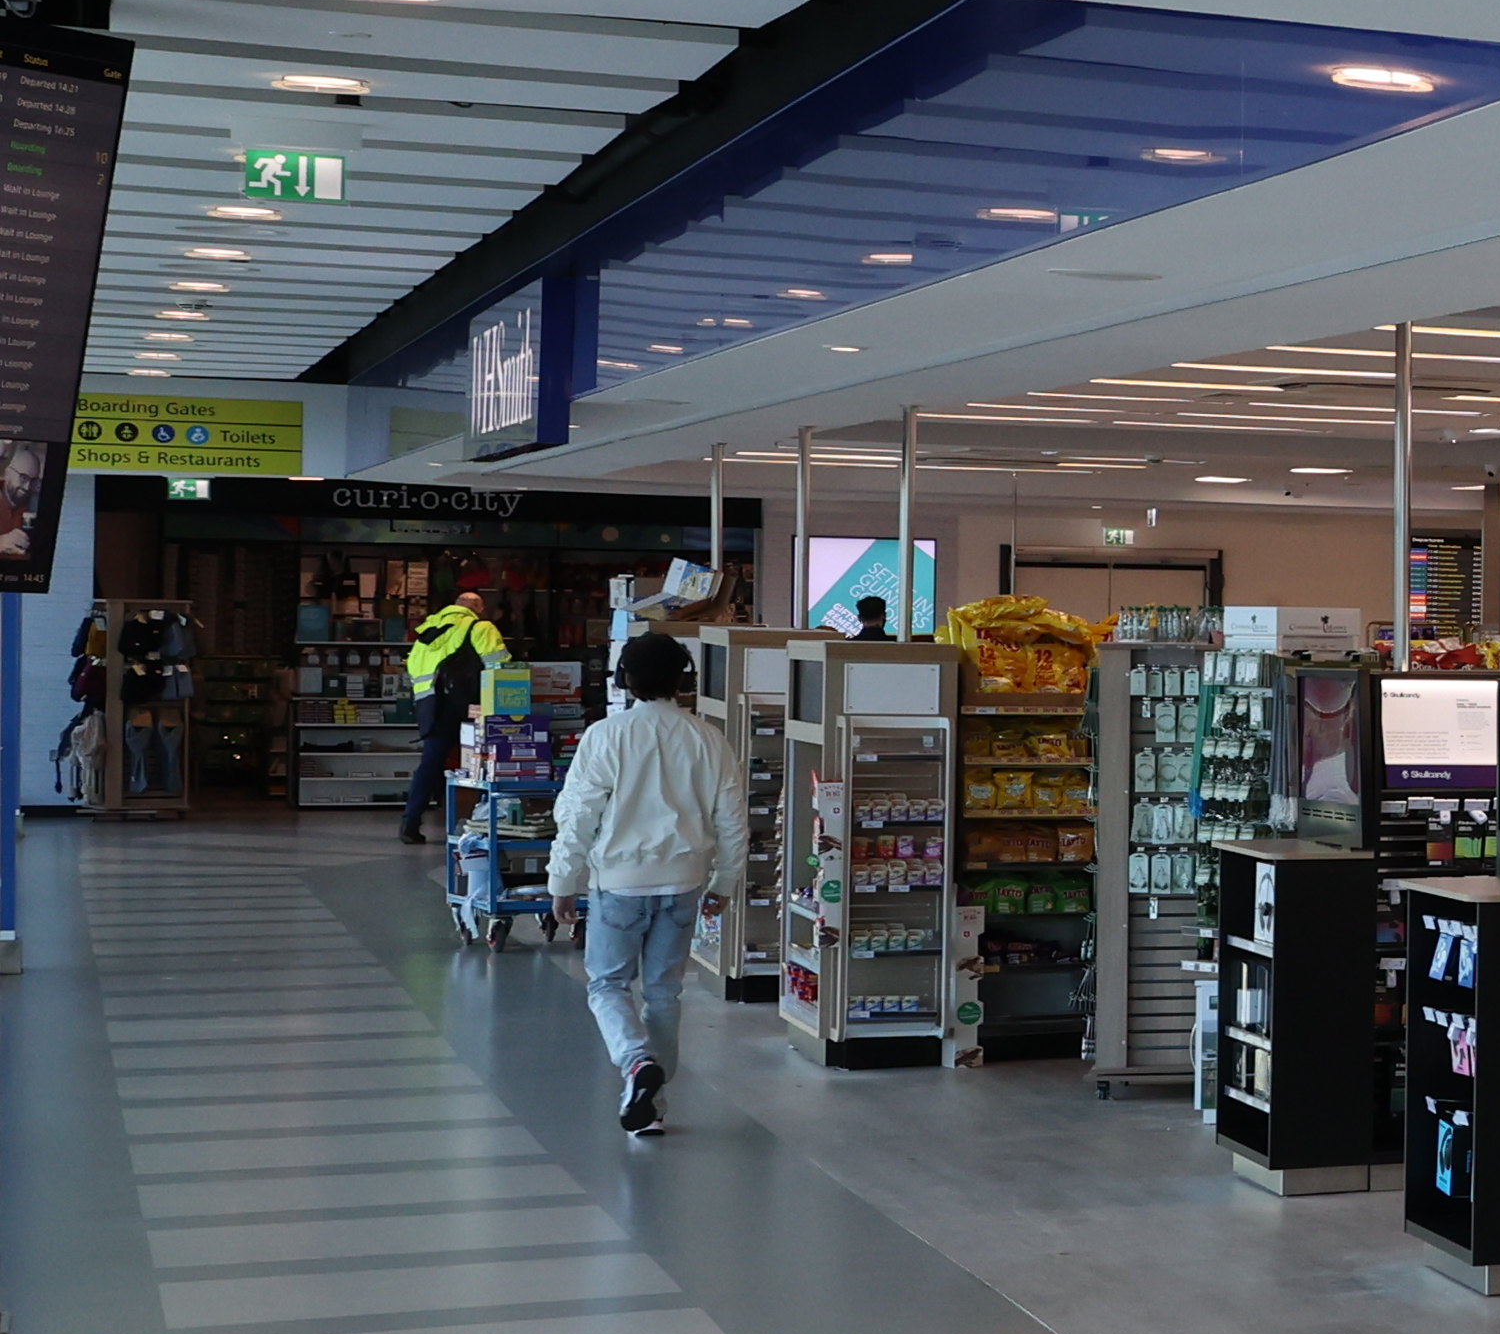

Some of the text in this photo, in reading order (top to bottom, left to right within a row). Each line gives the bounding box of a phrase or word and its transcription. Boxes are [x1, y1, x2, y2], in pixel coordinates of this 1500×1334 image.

[104, 69, 122, 79] Gate
[20, 75, 56, 90] Departed
[32, 186, 60, 202] Lounge
[469, 306, 534, 438] WHSmith
[77, 397, 216, 420] Boarding Gates
[220, 429, 276, 446] Toilets
[76, 447, 261, 469] Shops & Restaurants
[1410, 770, 1452, 780] Skullcandy
